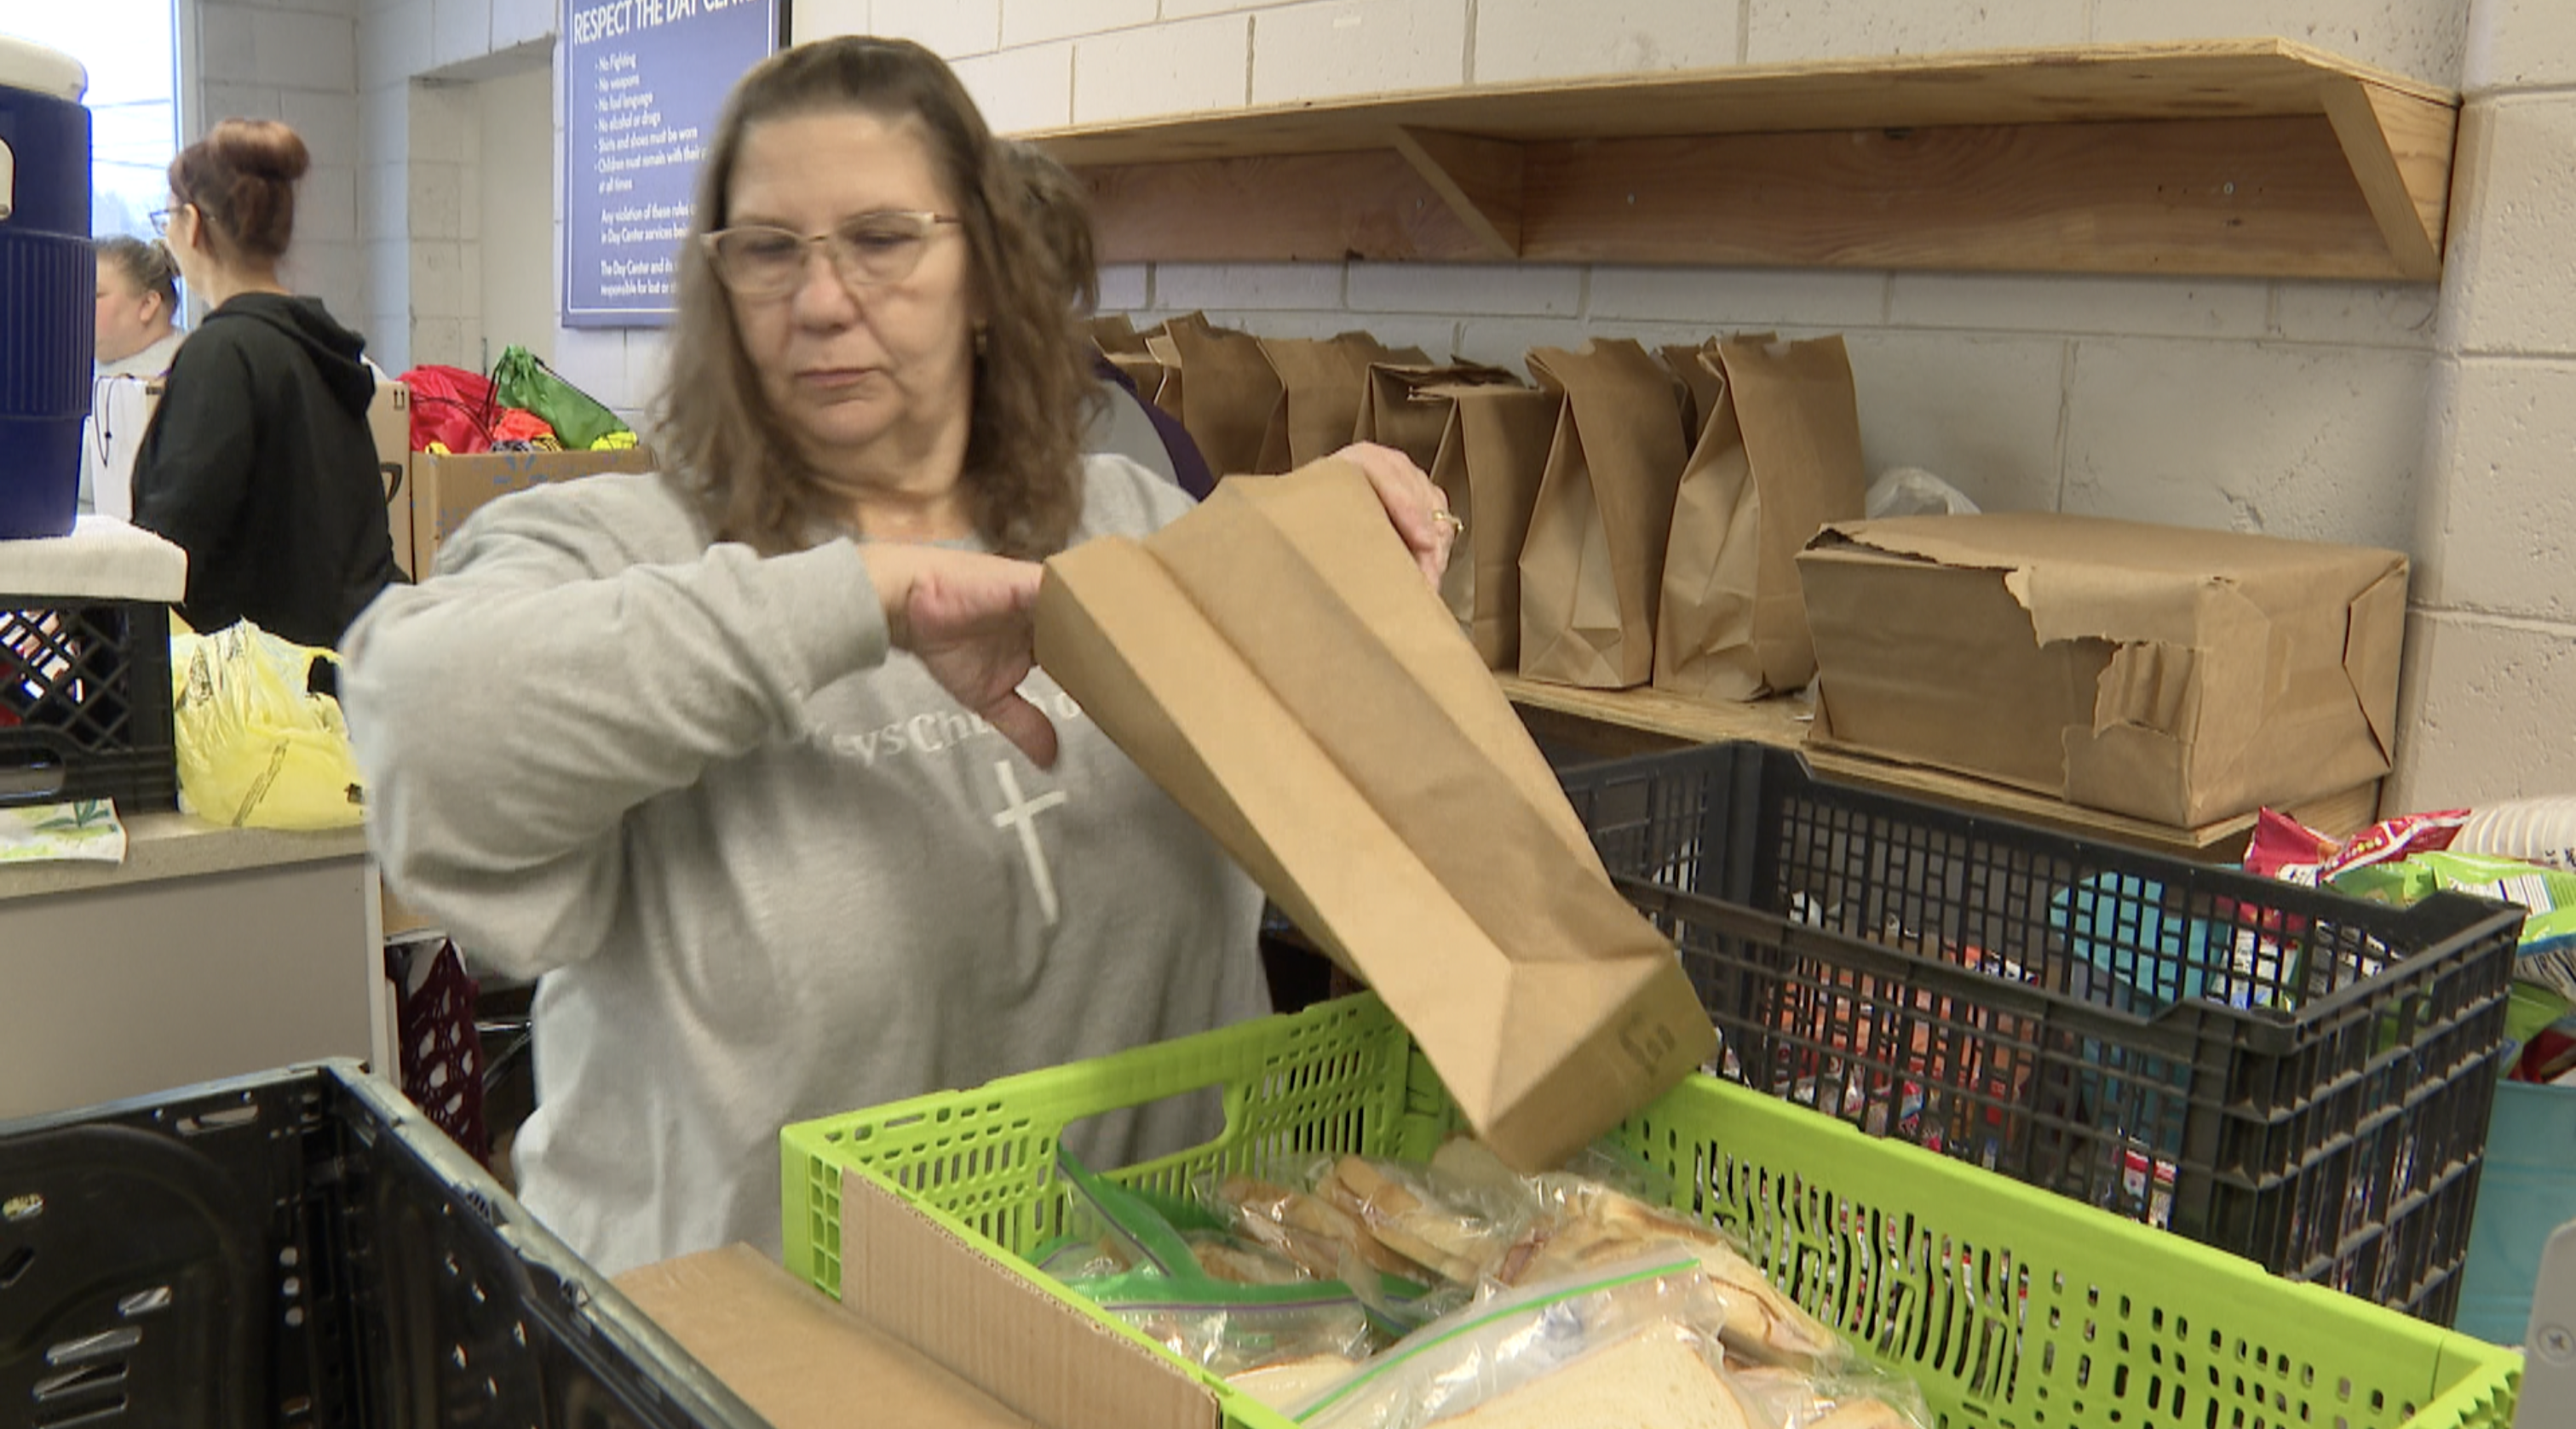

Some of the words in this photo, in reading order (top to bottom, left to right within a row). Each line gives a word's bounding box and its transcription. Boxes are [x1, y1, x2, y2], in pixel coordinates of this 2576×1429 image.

[573, 2, 633, 45] RESPECT
[633, 0, 664, 30] THE
[610, 52, 636, 72] Fighting
[610, 74, 639, 91] weapons
[622, 91, 653, 111] language
[609, 112, 632, 131] alcohol
[633, 116, 641, 128] or
[641, 109, 661, 128] drugs
[616, 133, 630, 152] and
[630, 131, 648, 149] shoes
[649, 129, 667, 146] must
[667, 125, 678, 144] be
[678, 126, 698, 142] worn
[598, 155, 625, 174] Children
[625, 153, 641, 170] must
[641, 149, 666, 168] remain
[666, 145, 682, 164] with
[683, 144, 700, 164] their
[606, 176, 614, 194] all
[614, 176, 633, 192] times
[601, 208, 614, 227] Any
[615, 205, 643, 222] violation
[643, 202, 652, 221] of
[652, 202, 671, 219] these
[671, 199, 689, 218] rules
[607, 227, 621, 247] Day
[622, 226, 644, 244] Center
[645, 224, 673, 241] services
[600, 259, 612, 277] The
[613, 258, 626, 279] Day
[627, 258, 650, 276] Center
[650, 256, 664, 275] and
[600, 278, 636, 298] responsible
[637, 278, 647, 295] for
[647, 278, 661, 295] lost
[661, 284, 670, 295] or
